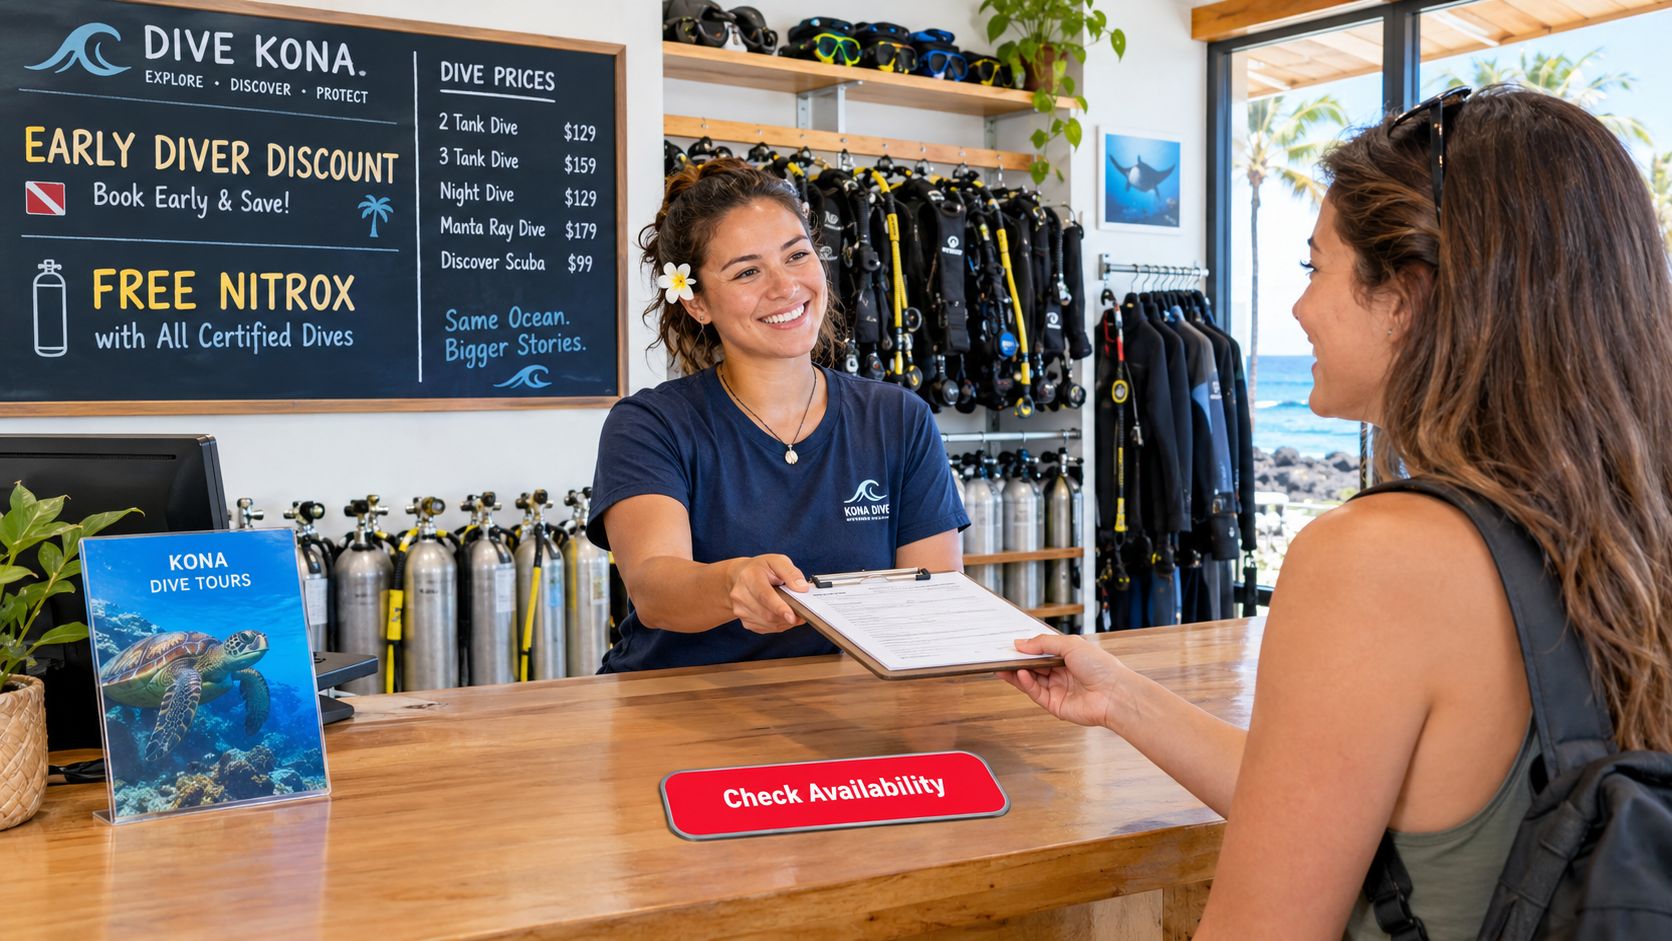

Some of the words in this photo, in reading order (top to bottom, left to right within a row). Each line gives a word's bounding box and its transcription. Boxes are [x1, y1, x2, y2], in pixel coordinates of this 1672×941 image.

[145, 25, 234, 64] DIVE
[146, 70, 203, 87] EXPLORE
[231, 78, 291, 95] DISCOVER
[317, 87, 368, 103] PROTECT
[441, 61, 484, 84] DIVE
[495, 67, 555, 91] PRICES
[439, 113, 448, 129] 2
[453, 114, 484, 132] Tank
[491, 117, 517, 135] Dive
[564, 122, 595, 141] $129
[26, 126, 135, 168] EARLY
[155, 135, 250, 175] DIVER
[268, 143, 398, 184] DISCOUNT
[440, 147, 448, 164] 3
[454, 148, 485, 166] Tank
[492, 151, 518, 168] Dive
[565, 155, 596, 174] $159
[94, 182, 144, 207] Book
[156, 186, 207, 218] Early
[218, 189, 232, 211] &
[241, 190, 289, 213] Save!
[441, 182, 479, 206] Night
[486, 184, 514, 202] Dive
[565, 188, 596, 207] $129
[441, 216, 483, 234] Manta
[490, 218, 513, 242] Ray
[520, 220, 545, 236] Dive
[566, 221, 596, 240] $179
[442, 251, 499, 269] Discover
[506, 253, 545, 270] Scuba
[568, 254, 592, 273] $99
[94, 269, 196, 309] FREE
[221, 272, 355, 311] NITROX
[445, 309, 498, 331] Same
[509, 306, 569, 328] Ocean.
[95, 322, 145, 349] with
[157, 322, 188, 348] All
[199, 321, 291, 354] Certified
[303, 323, 353, 346] Dives
[446, 338, 508, 368] Bigger
[518, 333, 586, 355] Stories.
[871, 504, 890, 515] DIVE
[169, 552, 228, 570] KONA
[151, 578, 190, 593] DIVE
[195, 574, 251, 589] TOURS
[724, 785, 803, 808] Check
[810, 775, 944, 802] Availability
